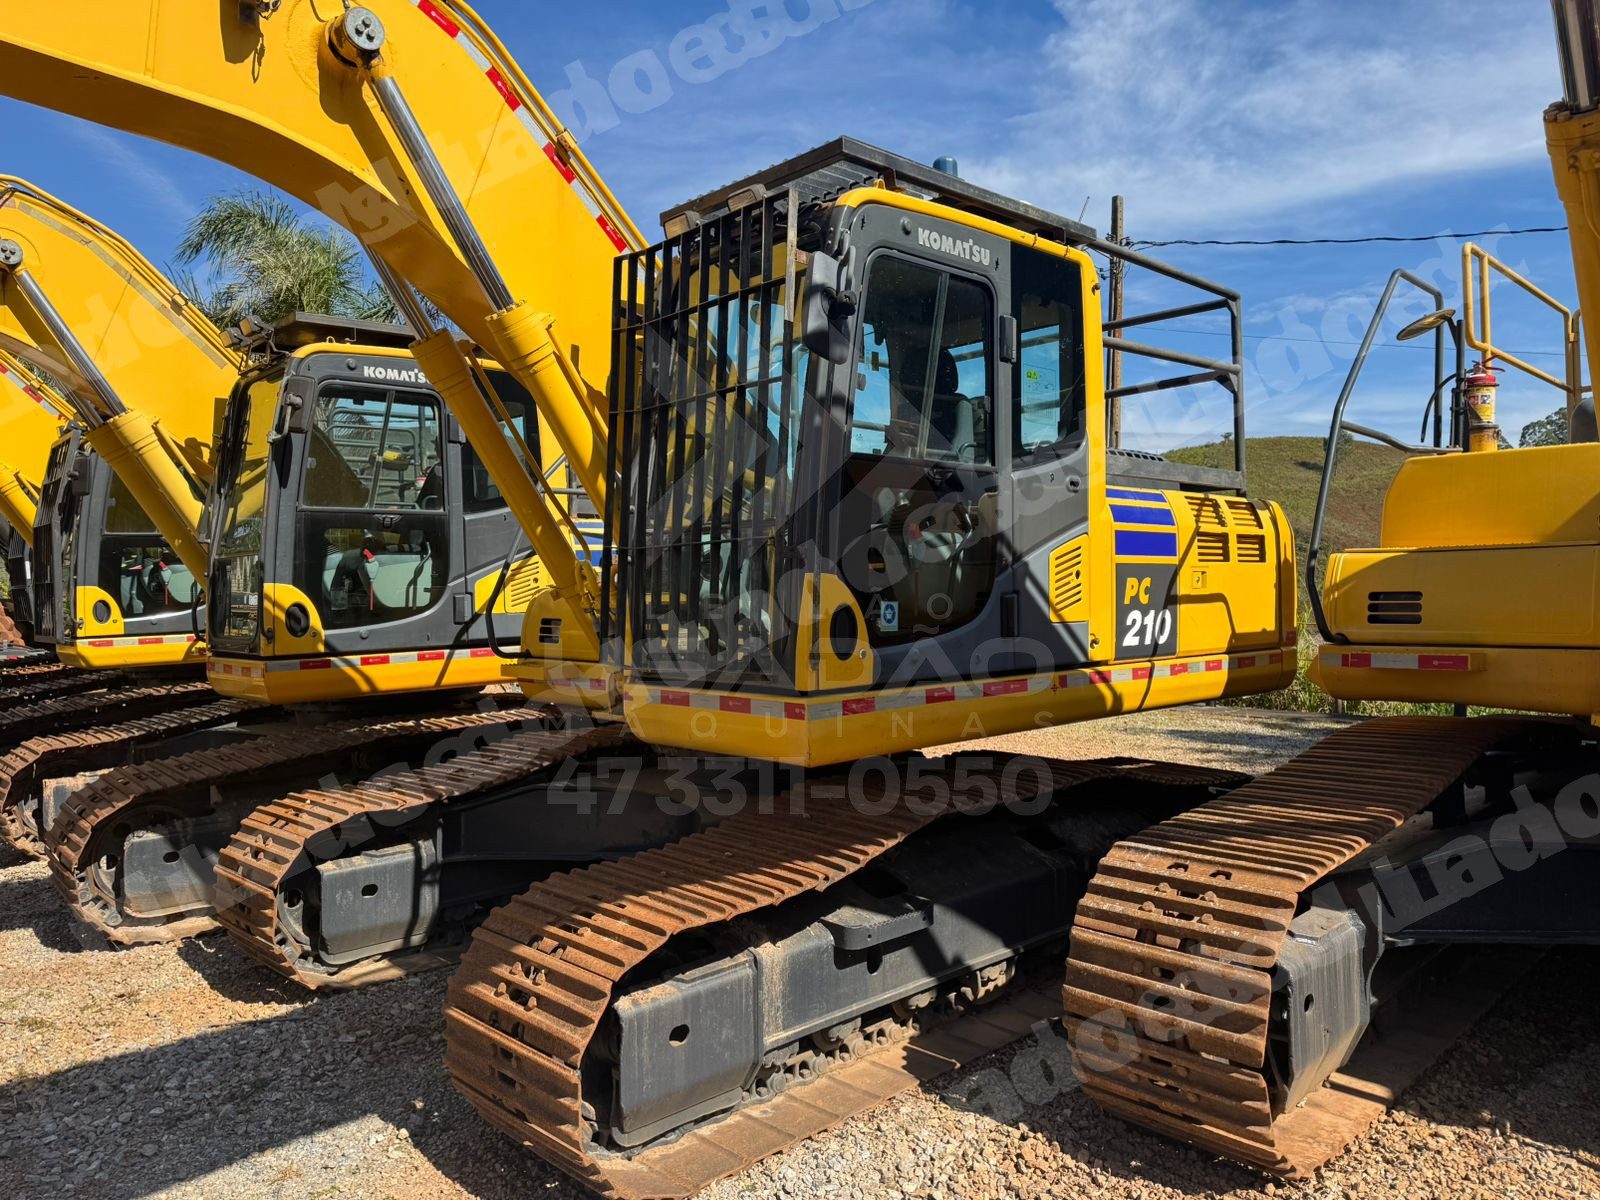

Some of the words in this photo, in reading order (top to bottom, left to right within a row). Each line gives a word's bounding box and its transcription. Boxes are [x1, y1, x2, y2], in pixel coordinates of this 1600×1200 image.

[917, 227, 990, 266] KOMATSU
[363, 365, 431, 384] KOMATS
[1124, 576, 1152, 605] PC
[1122, 609, 1172, 647] 210
